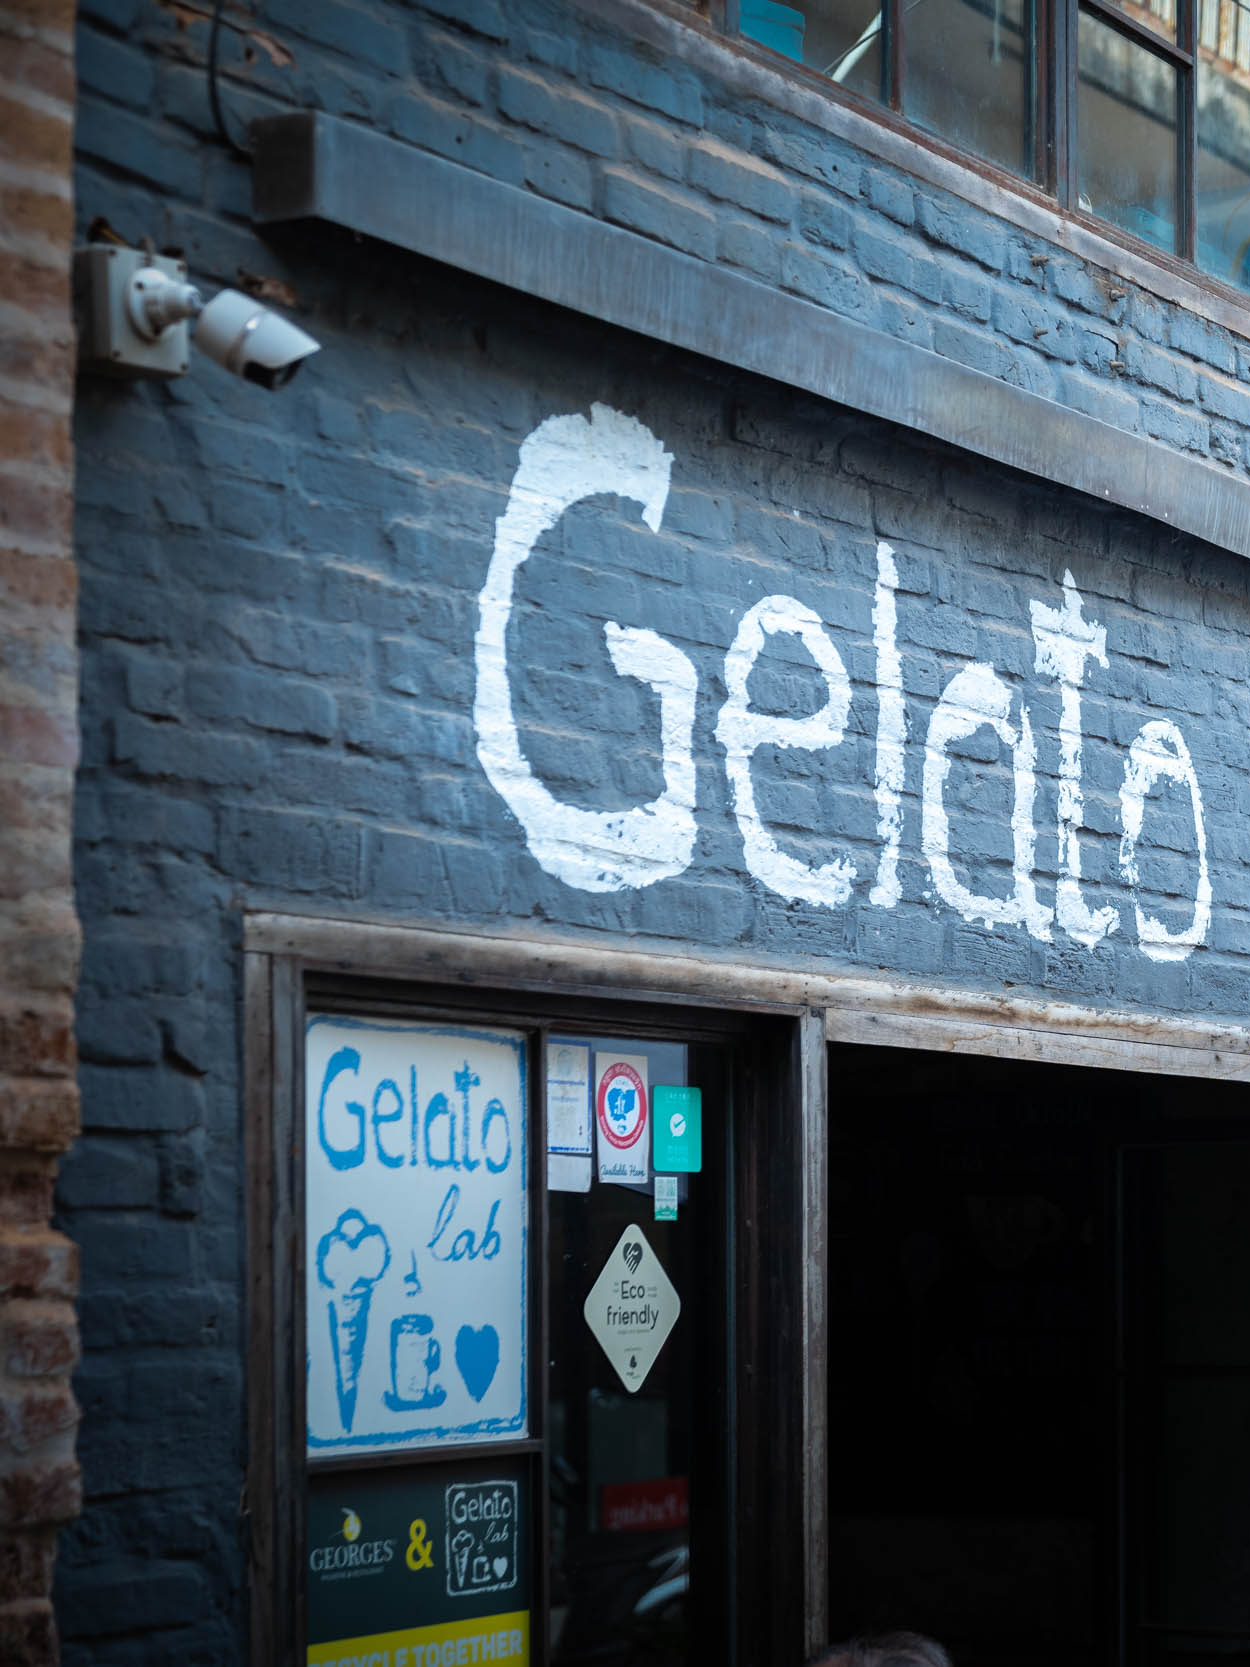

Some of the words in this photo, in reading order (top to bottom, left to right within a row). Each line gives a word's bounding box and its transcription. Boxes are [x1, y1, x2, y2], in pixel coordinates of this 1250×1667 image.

[473, 401, 1212, 962] Gelato
[318, 1044, 511, 1173] Gelato
[427, 1183, 502, 1263] lab
[621, 1279, 646, 1300] Eco
[606, 1303, 659, 1329] friendly
[450, 1488, 512, 1525] Gelato
[309, 1539, 395, 1573] GEORGES
[405, 1519, 434, 1572] &
[484, 1521, 510, 1544] lab
[413, 1628, 523, 1667] TOGETHER
